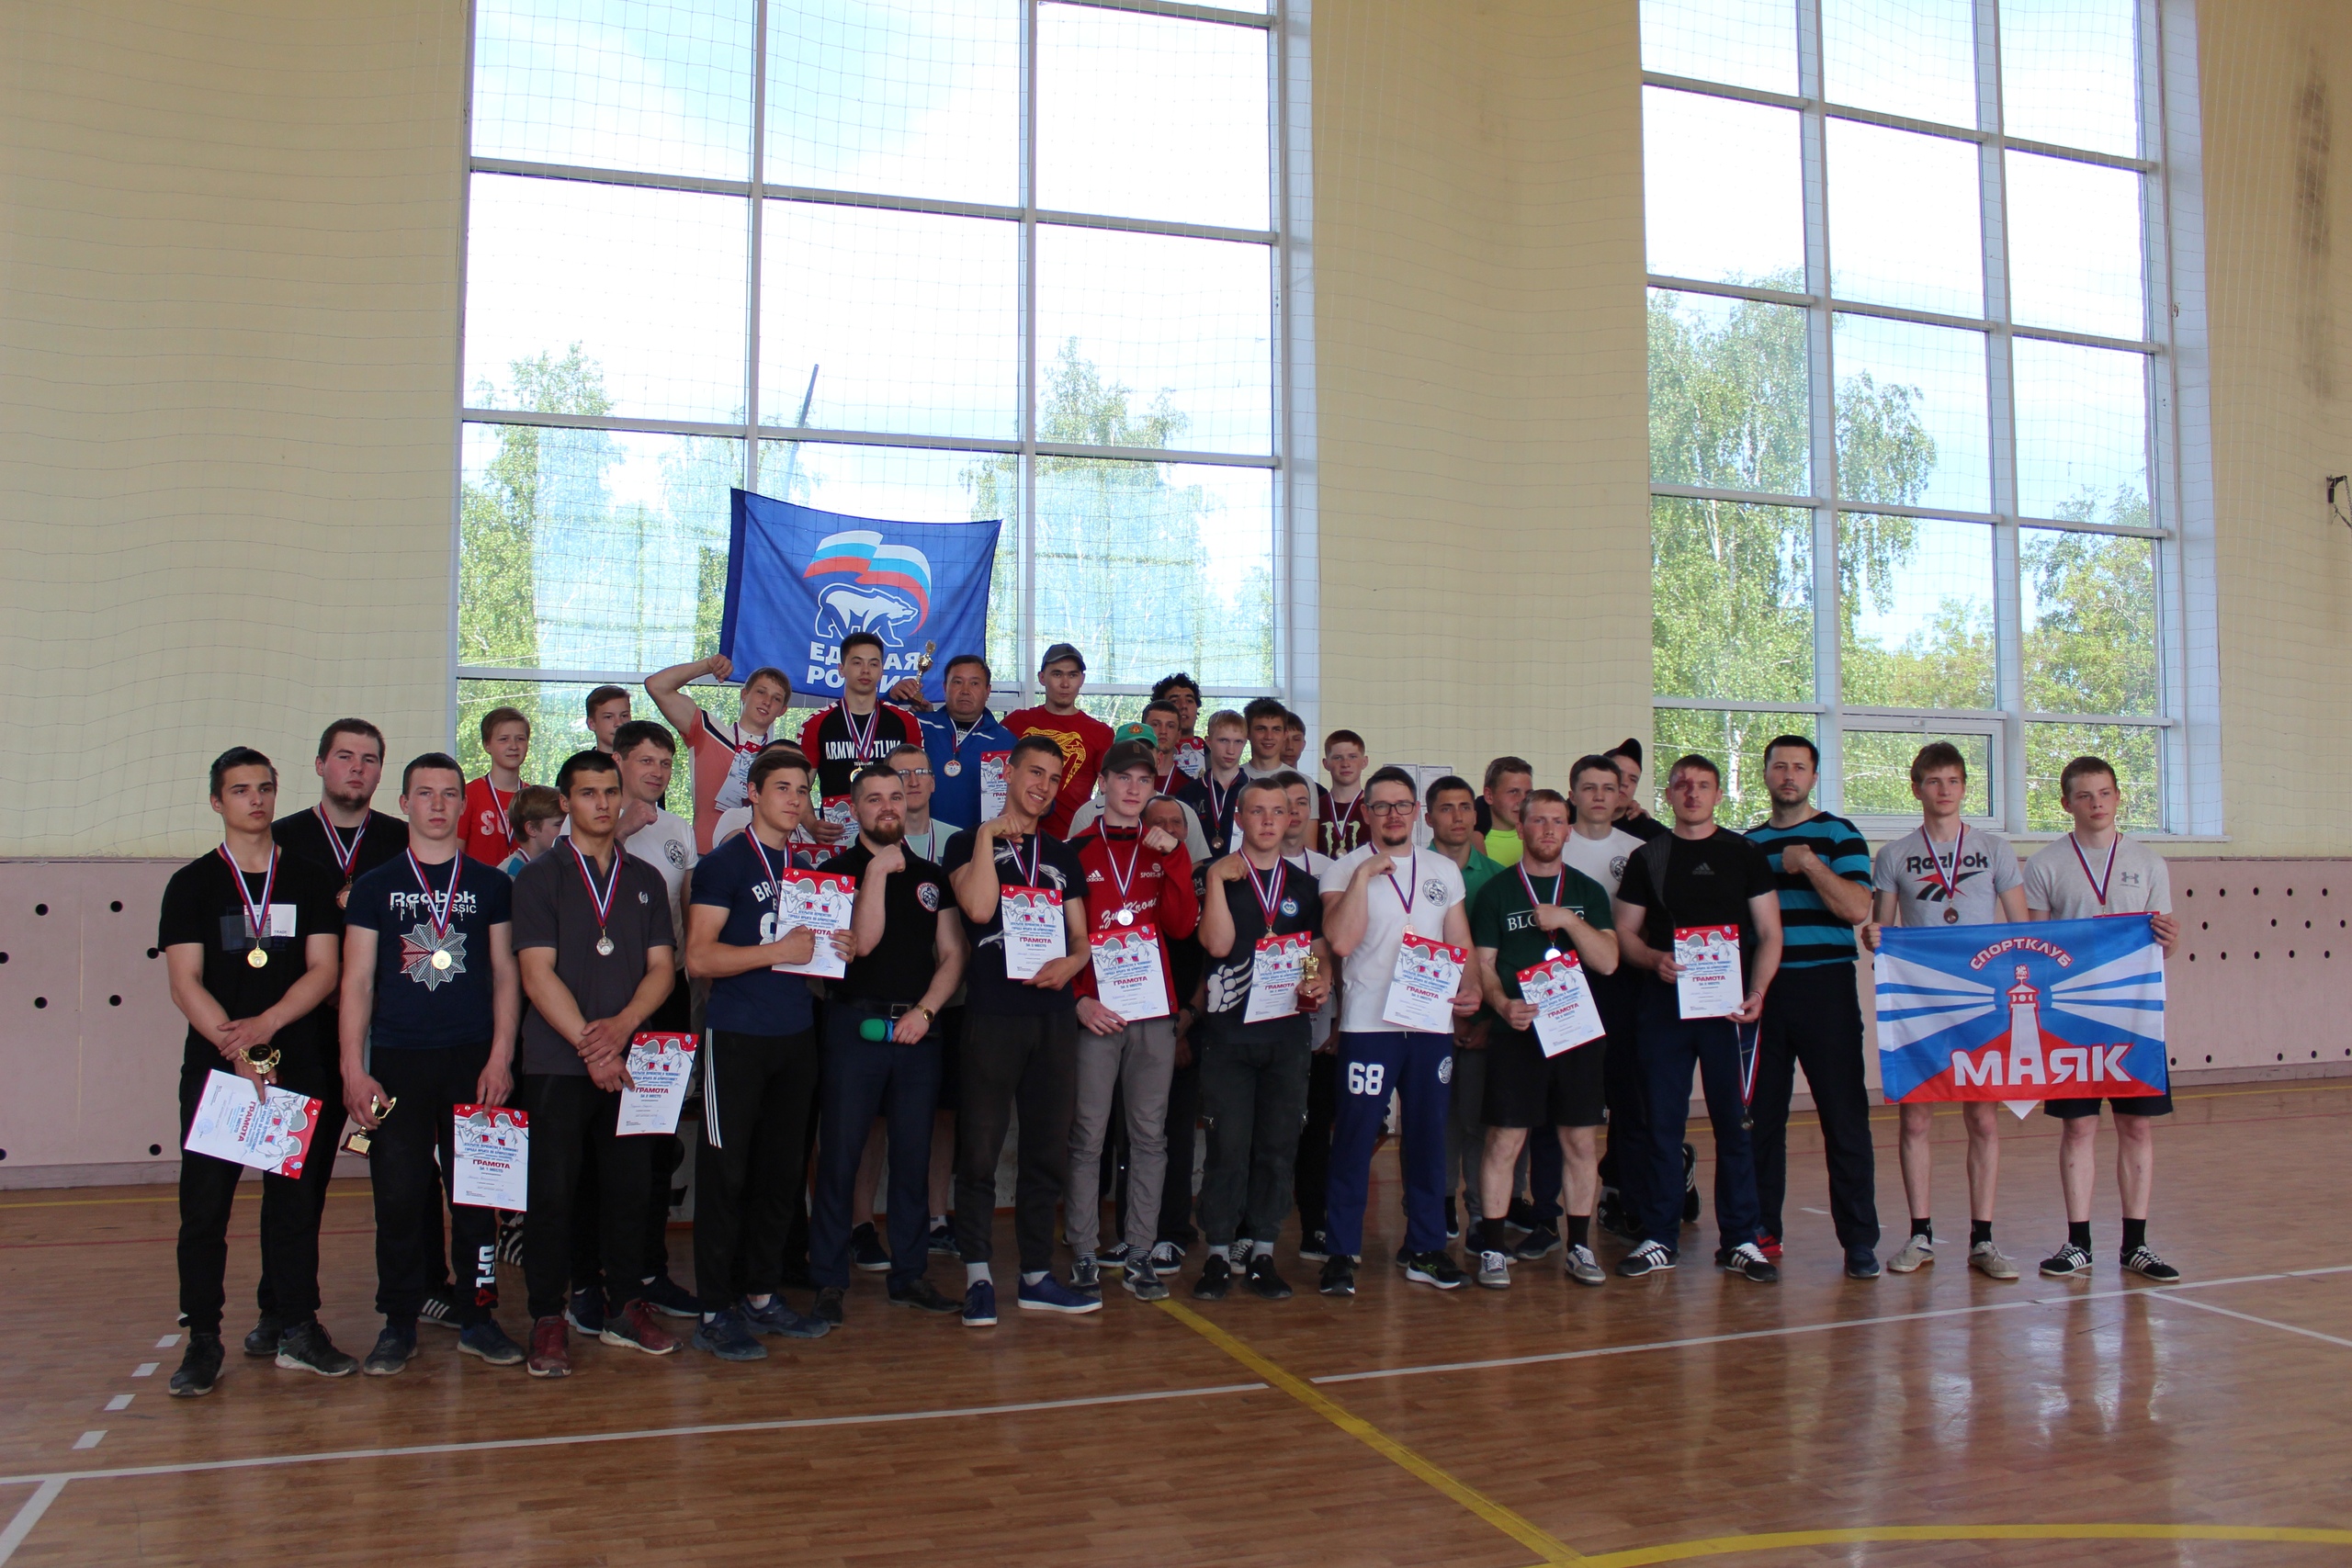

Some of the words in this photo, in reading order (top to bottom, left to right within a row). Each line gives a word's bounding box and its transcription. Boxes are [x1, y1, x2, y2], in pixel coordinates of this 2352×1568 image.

[809, 641, 920, 671] ЕДАЯ
[806, 665, 918, 694] РОИ
[1019, 936, 1052, 945] ГРАМОТА
[1970, 937, 2073, 970] СПОРТКЛУБ
[1113, 975, 1148, 986] ГРАМОТА
[1264, 982, 1295, 990] ГРАМОТА
[1406, 986, 1439, 998] ГРАМОТА
[1547, 1001, 1579, 1018] ГРАМОТА
[1951, 1043, 2133, 1087] МАЯК
[1348, 1061, 1385, 1095] 68
[237, 1100, 256, 1143] ГРАМОТА
[472, 1158, 510, 1168] ГРАМОТА
